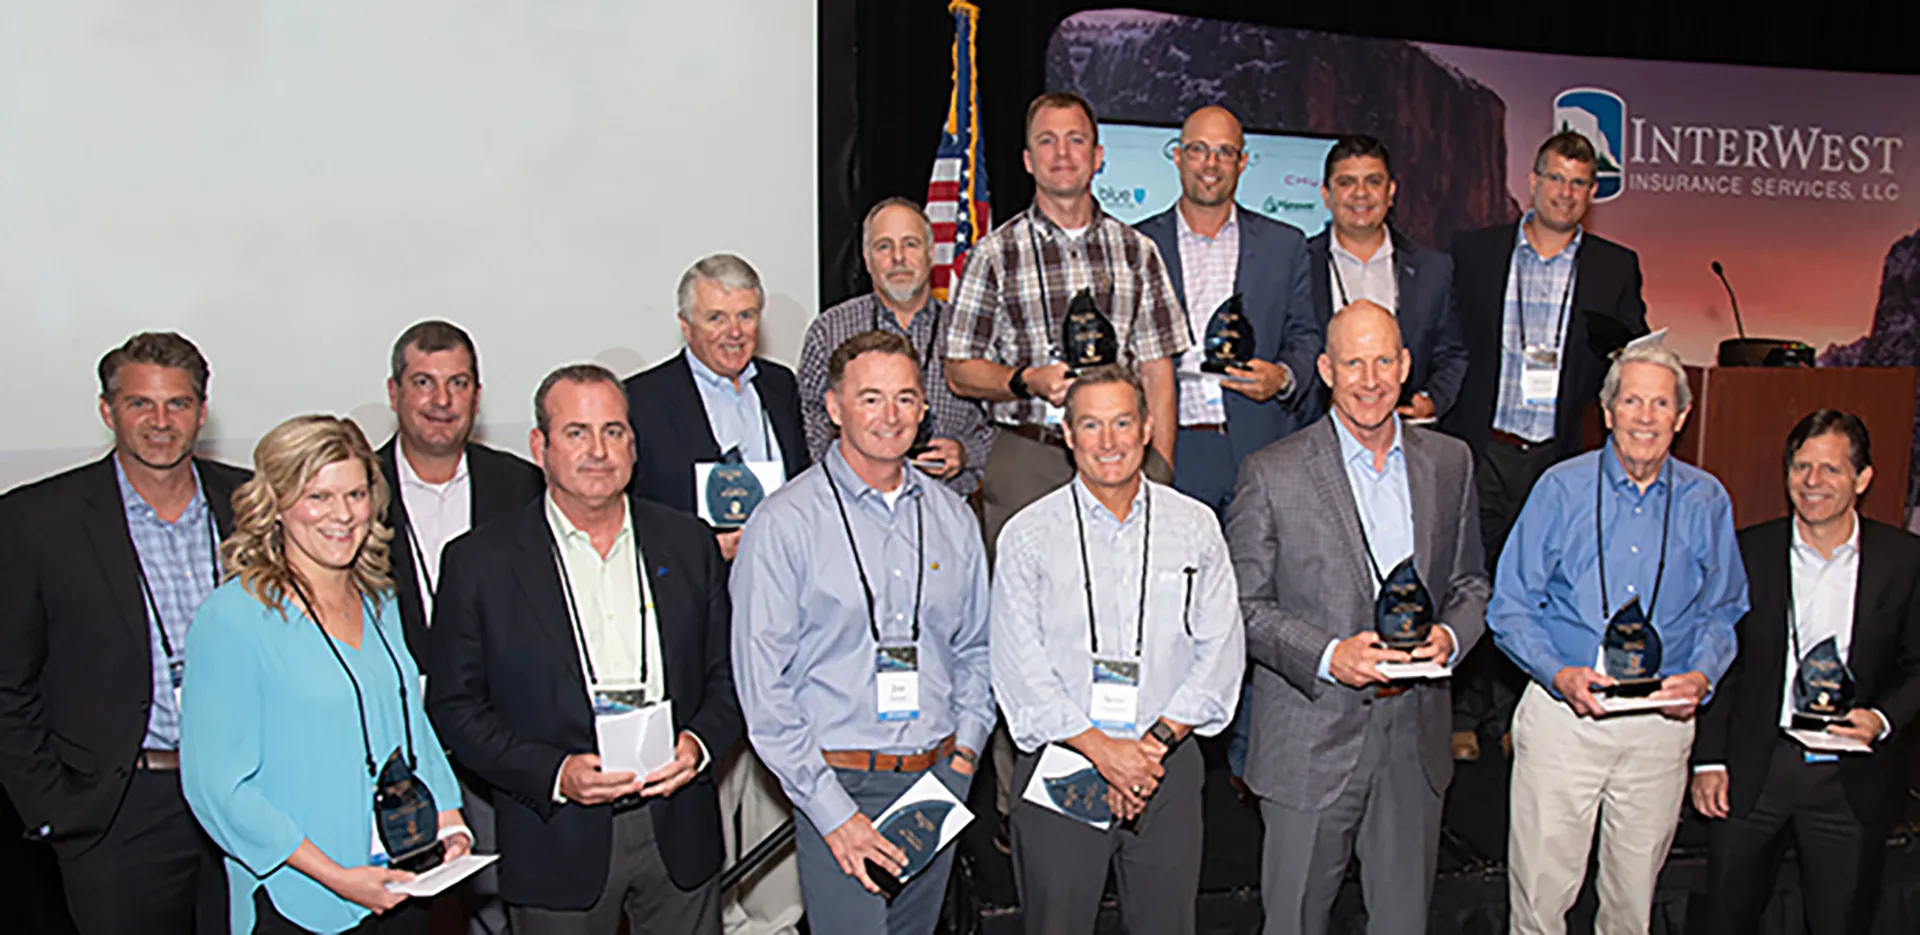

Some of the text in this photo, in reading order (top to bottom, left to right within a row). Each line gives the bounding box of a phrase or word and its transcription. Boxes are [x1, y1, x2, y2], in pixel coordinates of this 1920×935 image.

[1629, 173, 1900, 201] INSURANCE SERVICES, LLC
